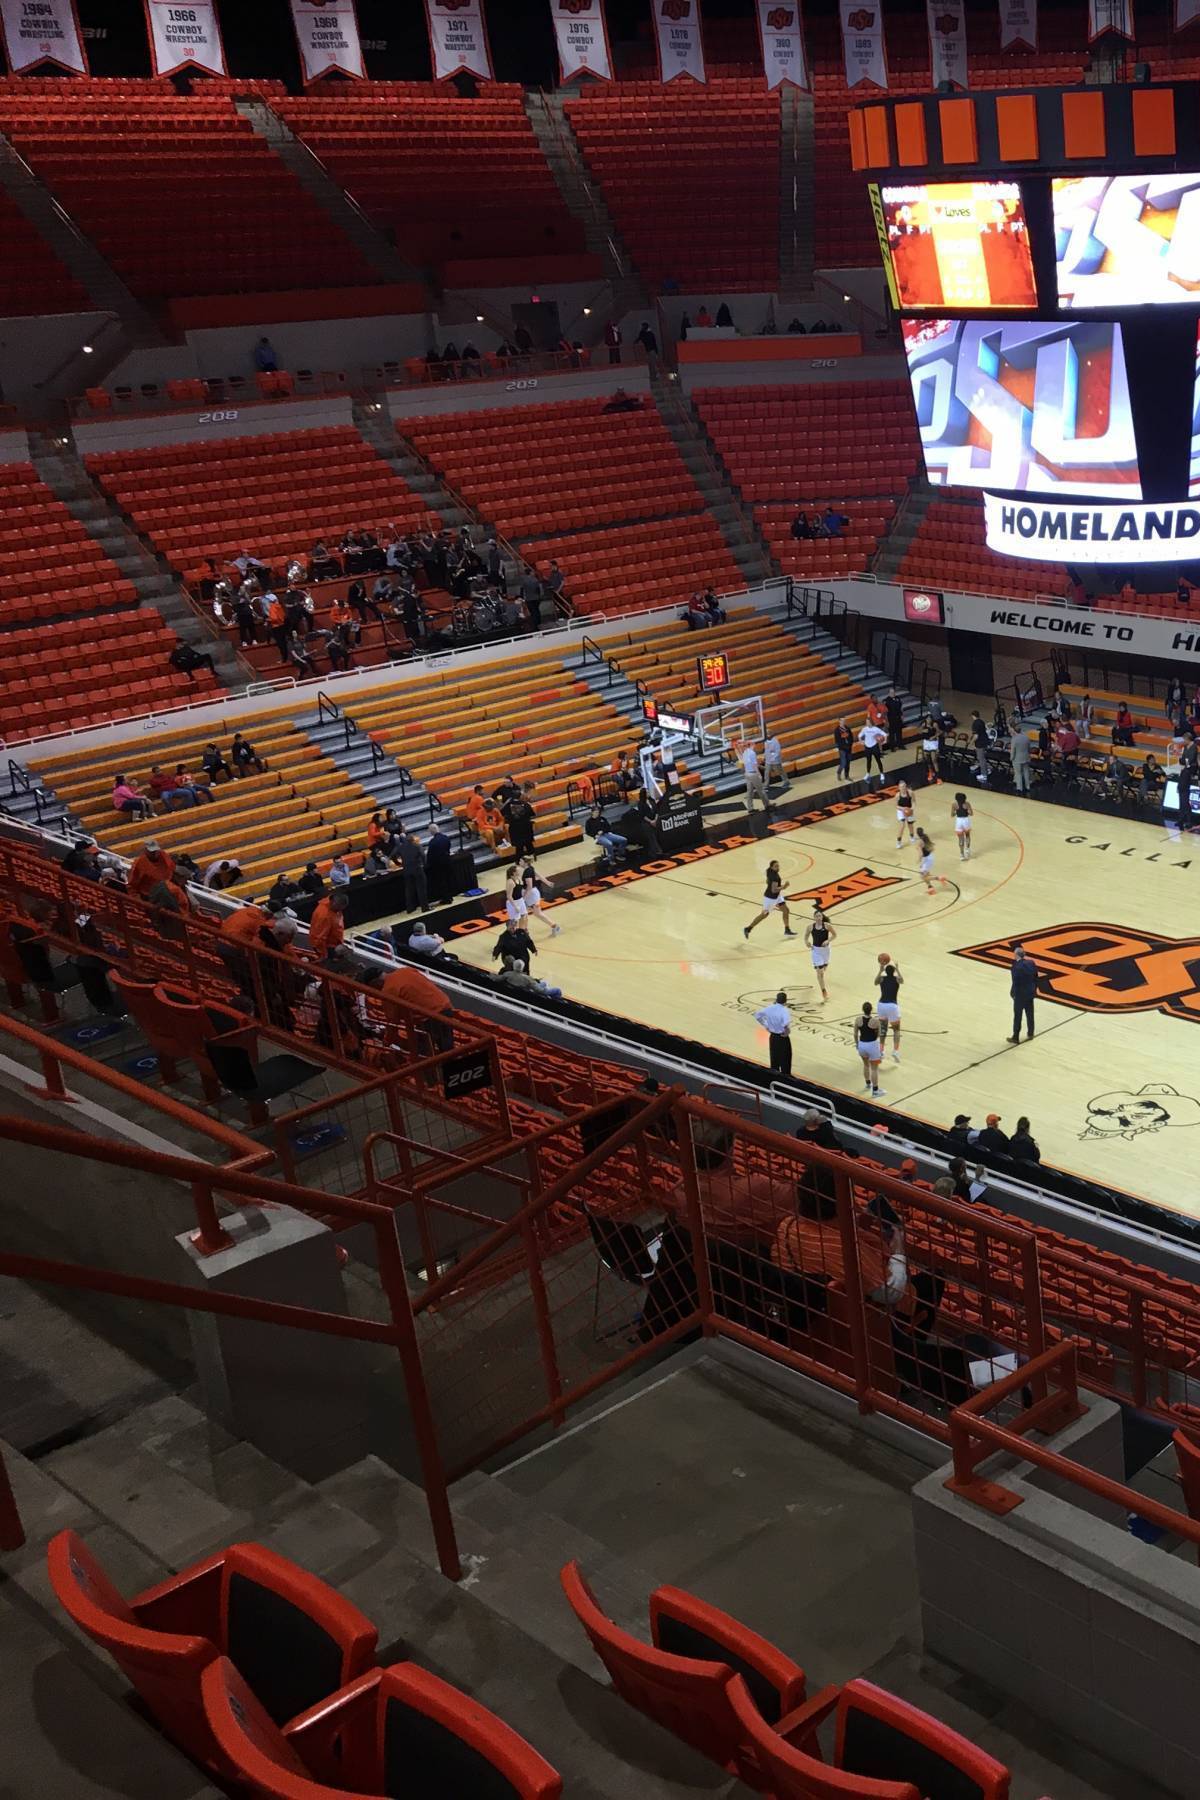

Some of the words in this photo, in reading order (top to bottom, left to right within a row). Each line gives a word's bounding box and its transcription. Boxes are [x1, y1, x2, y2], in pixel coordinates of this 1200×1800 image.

[168, 10, 197, 22] 1966
[20, 19, 60, 29] COWBOY
[446, 20, 469, 32] 1971
[568, 23, 590, 34] 1976
[19, 29, 65, 39] WRESTLING
[166, 25, 203, 35] COWBOY
[165, 35, 208, 44] WRESTLING
[311, 31, 343, 41] COWBOY
[445, 34, 474, 43] COWBOY
[567, 36, 595, 45] COWBOY
[310, 41, 350, 49] WRESTLING
[869, 188, 891, 264] Hertz
[810, 359, 838, 369] 210
[505, 379, 538, 391] 209
[199, 410, 239, 423] 208
[990, 610, 1096, 637] WELCOME
[1103, 624, 1135, 642] TO
[706, 667, 724, 686] 30
[447, 1065, 485, 1088] 202
